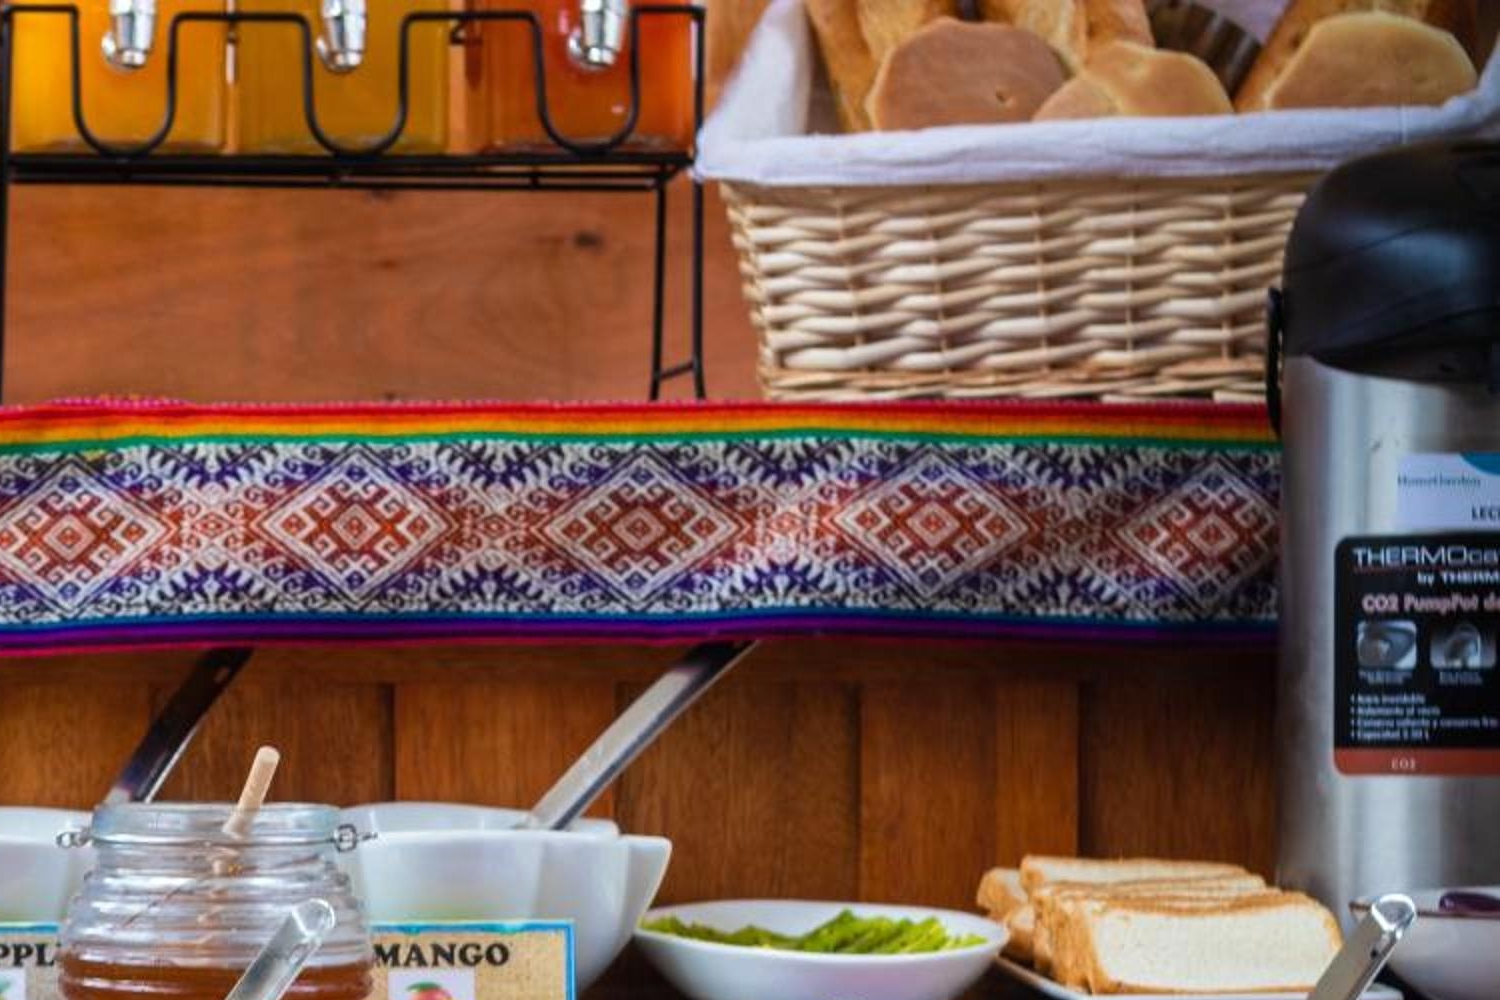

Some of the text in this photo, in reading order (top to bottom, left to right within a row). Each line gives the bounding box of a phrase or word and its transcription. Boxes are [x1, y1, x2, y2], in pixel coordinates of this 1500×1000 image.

[1471, 505, 1500, 521] LEC
[1353, 545, 1500, 567] THERMOca
[1417, 571, 1435, 587] by
[373, 943, 510, 968] MANGO
